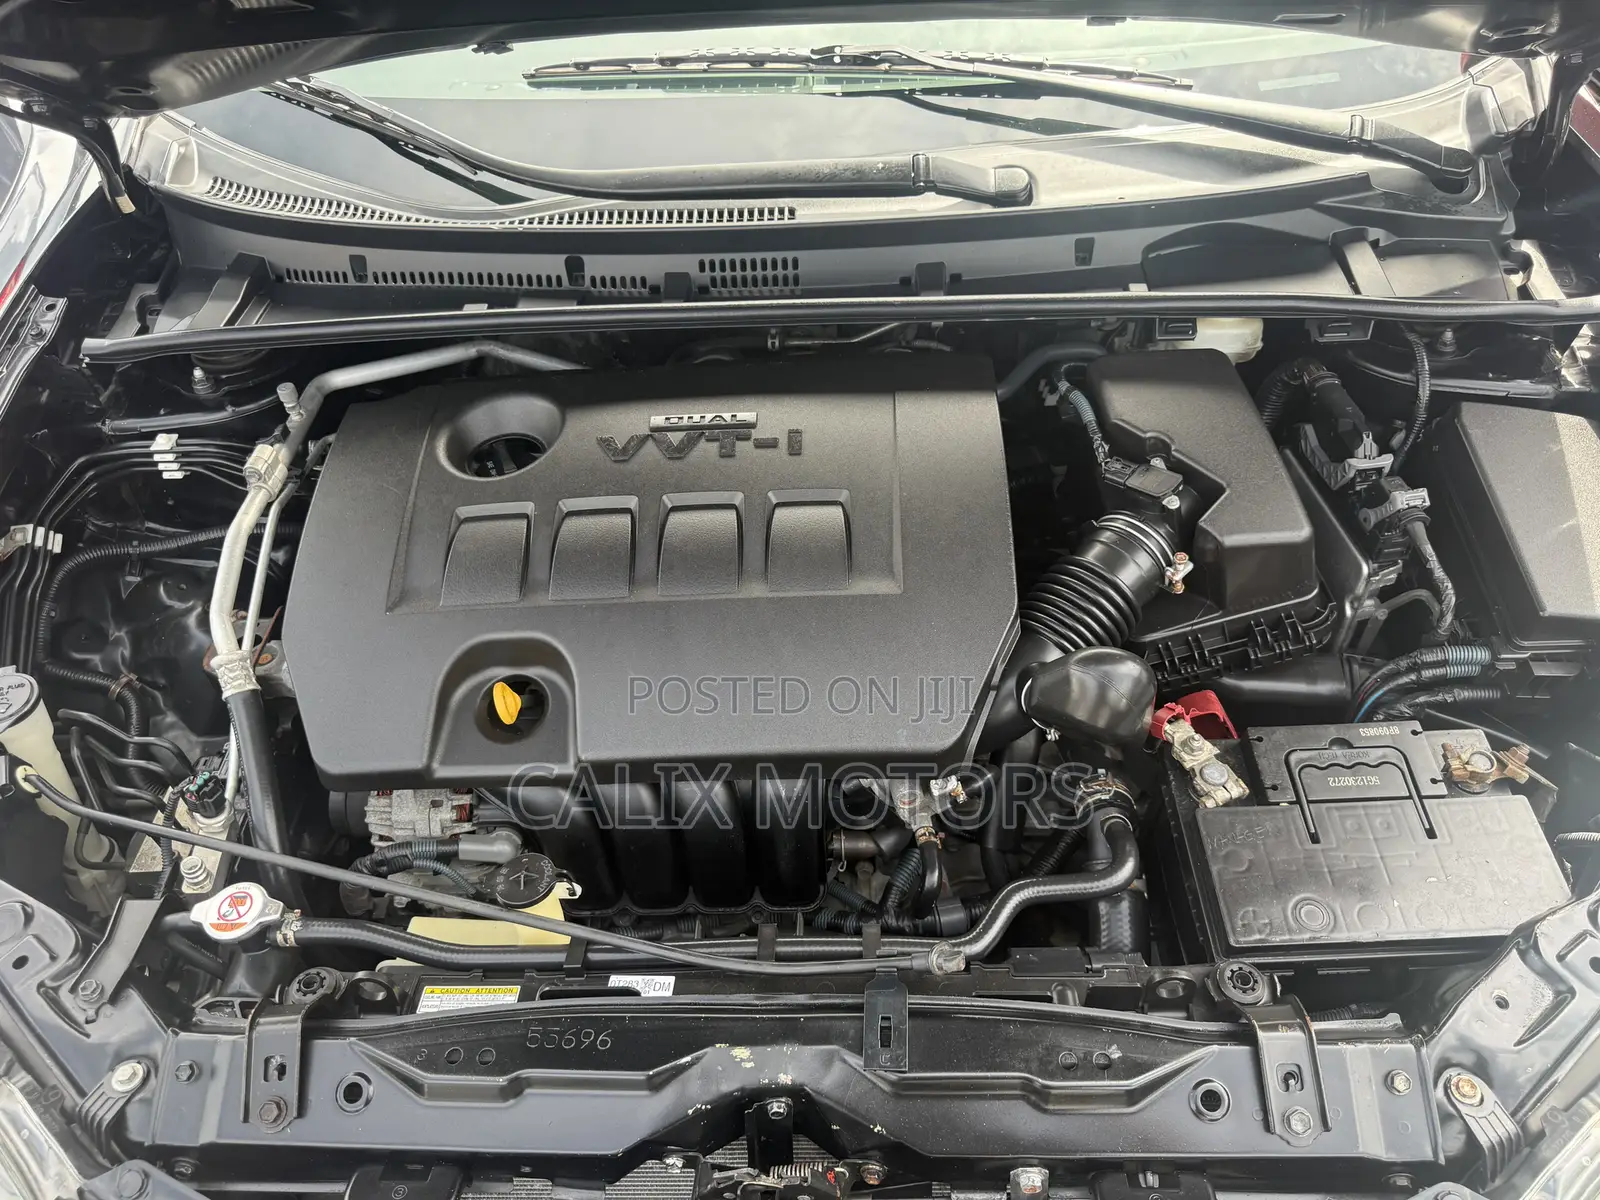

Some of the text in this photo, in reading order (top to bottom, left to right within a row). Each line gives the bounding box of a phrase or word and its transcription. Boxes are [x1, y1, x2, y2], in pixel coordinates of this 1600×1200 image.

[664, 413, 747, 424] DUAL
[1327, 775, 1381, 788] 5G1230272
[653, 981, 671, 992] DM
